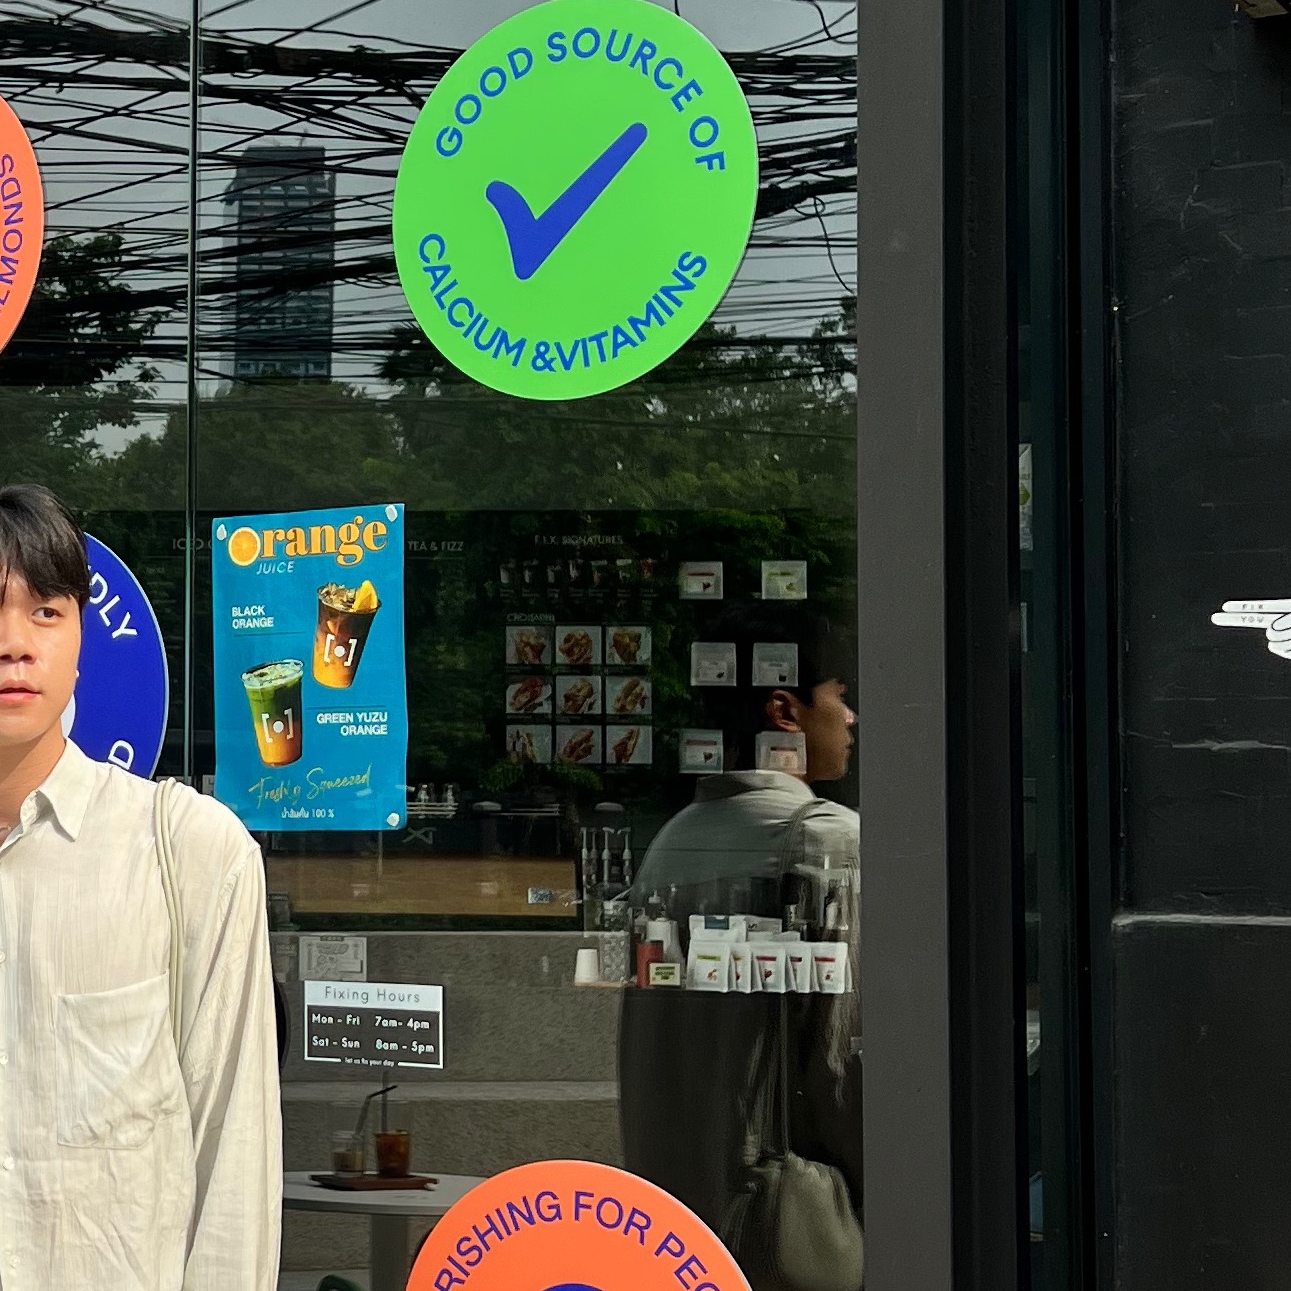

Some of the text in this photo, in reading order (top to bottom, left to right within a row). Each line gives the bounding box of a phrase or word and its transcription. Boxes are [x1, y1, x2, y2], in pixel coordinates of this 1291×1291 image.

[435, 27, 726, 173] GOOD SOURCE OF
[418, 233, 527, 368] CALCIUM
[227, 515, 388, 568] Orange
[256, 560, 295, 575] JUICE
[231, 604, 266, 617] BLACK
[232, 616, 274, 630] ORANGE
[316, 711, 388, 725] GREEN YUZU
[340, 724, 388, 736] ORANGE
[311, 808, 327, 819] 100
[325, 985, 420, 1004] Fixing Hours
[312, 1013, 334, 1025] Mon
[346, 1014, 361, 1026] Fri
[407, 1017, 430, 1031] 4pm
[312, 1035, 329, 1047] Sat
[341, 1036, 361, 1049] Sun
[375, 1038, 399, 1051] 8am
[411, 1040, 435, 1055] 5pm
[573, 1190, 653, 1246] FOR
